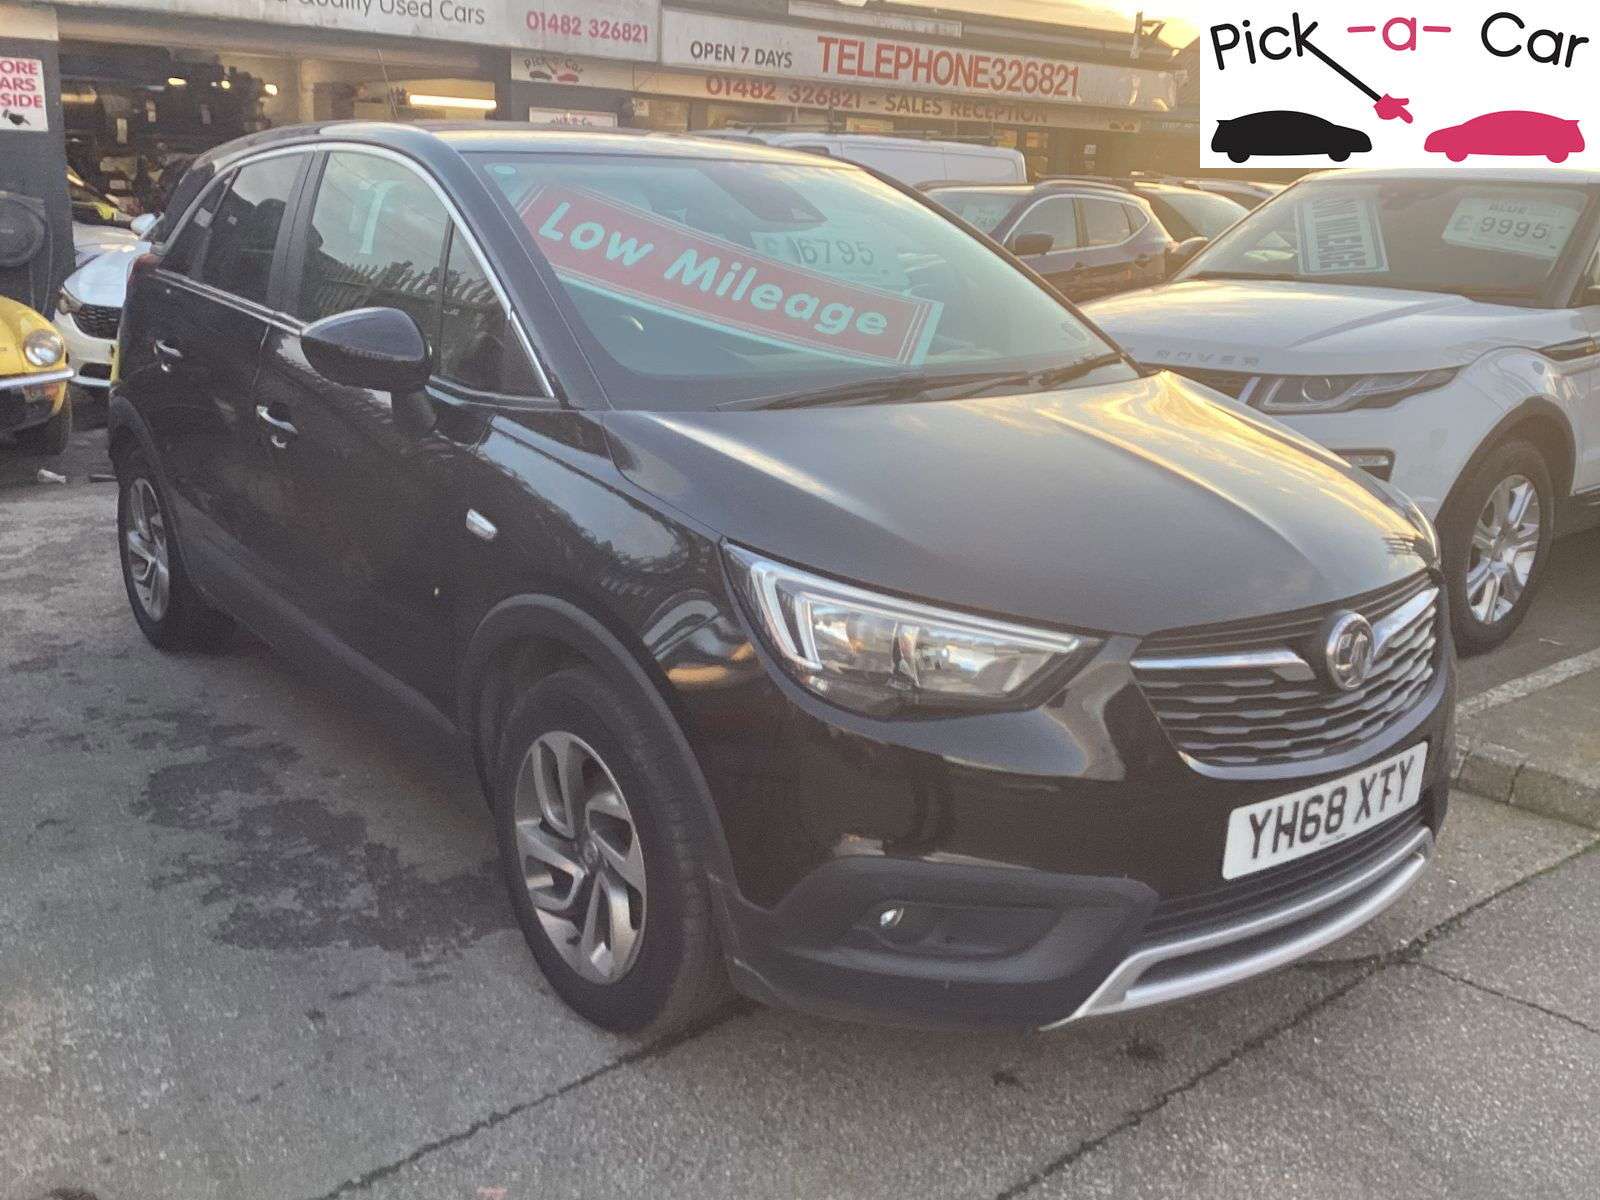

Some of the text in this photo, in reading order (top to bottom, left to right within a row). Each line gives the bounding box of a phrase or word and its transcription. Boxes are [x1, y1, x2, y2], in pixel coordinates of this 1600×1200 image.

[300, 0, 486, 25] ality Used Cars
[526, 10, 648, 43] 01482 326821
[690, 40, 735, 62] OPEN
[740, 47, 750, 64] 7
[754, 48, 793, 69] DAYS
[705, 75, 776, 100] 01482
[788, 84, 861, 108] 326821
[884, 94, 943, 116] SALES
[951, 101, 1048, 123] RECEPTION
[1480, 215, 1549, 240] 9995
[537, 201, 889, 336] Low Mileage
[1249, 754, 1415, 859] YH68 XTY
